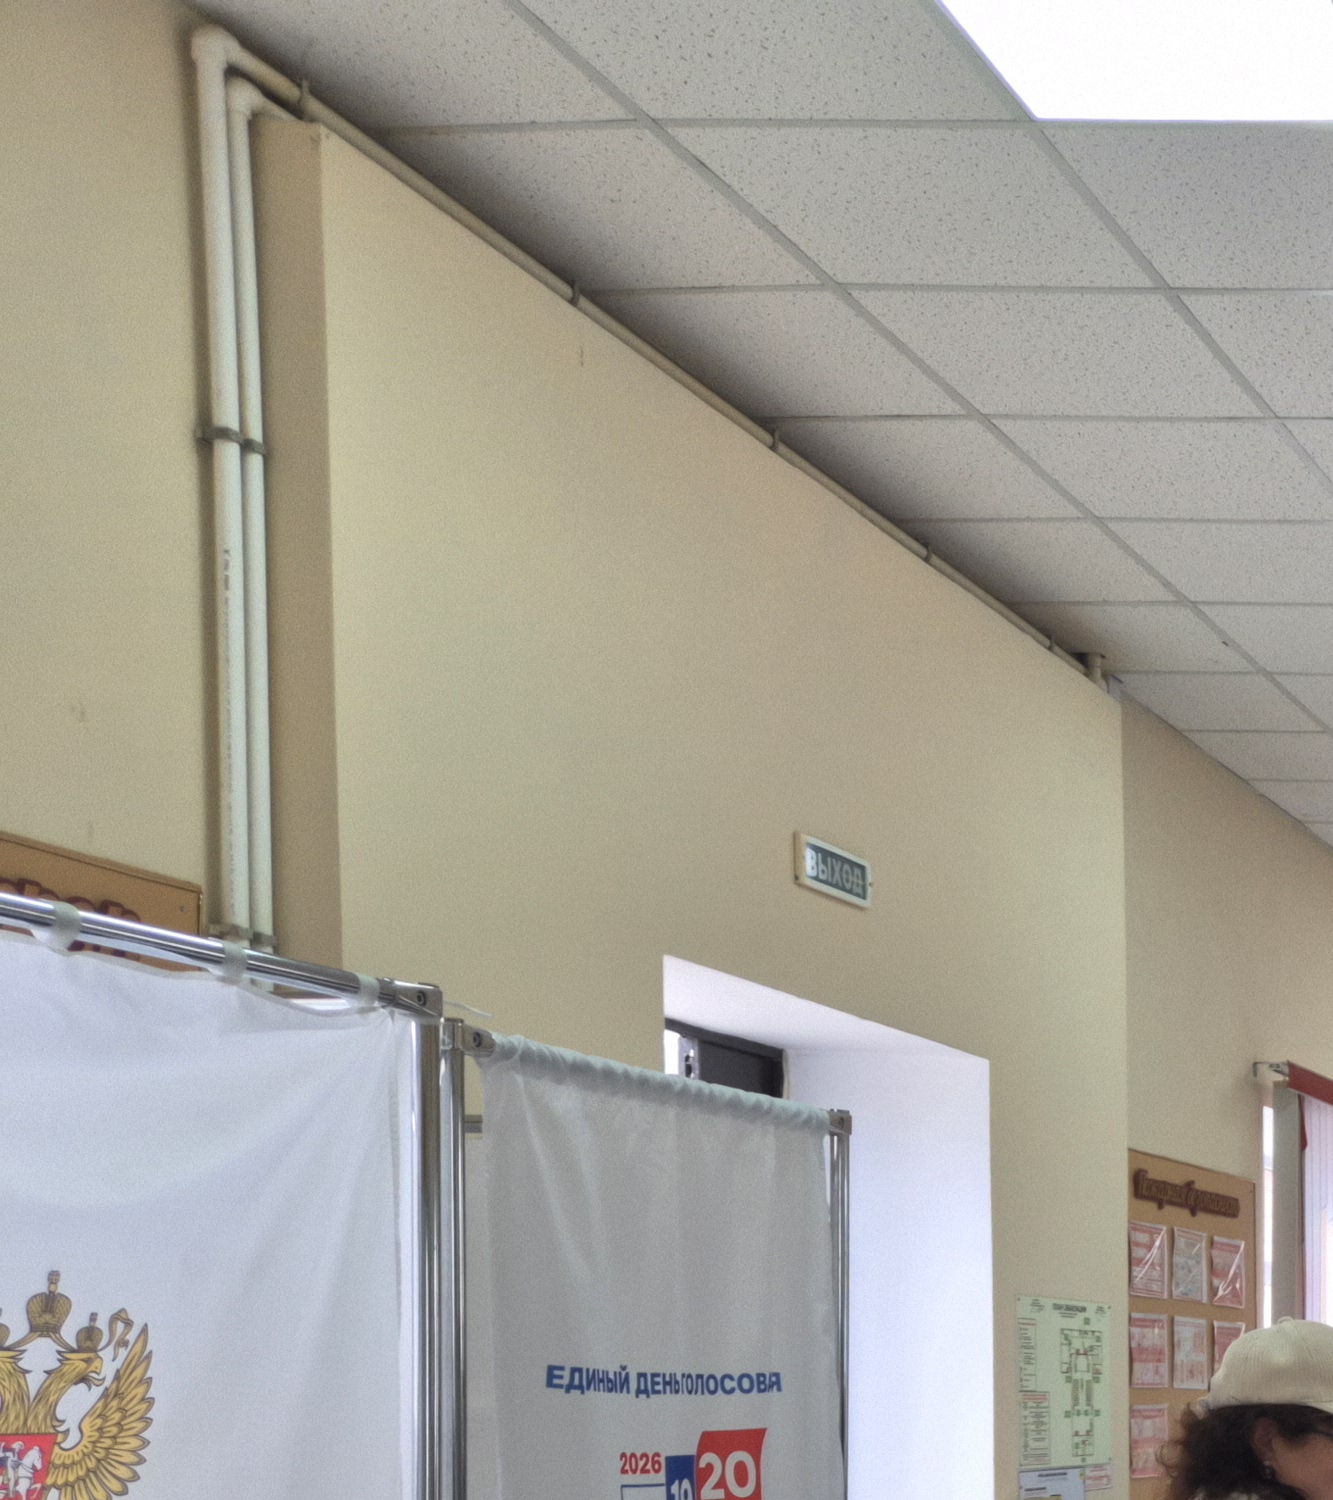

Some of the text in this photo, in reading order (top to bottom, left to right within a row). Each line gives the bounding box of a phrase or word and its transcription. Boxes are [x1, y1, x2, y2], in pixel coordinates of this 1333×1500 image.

[805, 847, 864, 898] ВЫХОД
[545, 1364, 631, 1395] ЕДИНЫЙ
[635, 1371, 680, 1398] ДЕНЬ
[619, 1451, 662, 1475] 2026
[699, 1450, 757, 1500] 20
